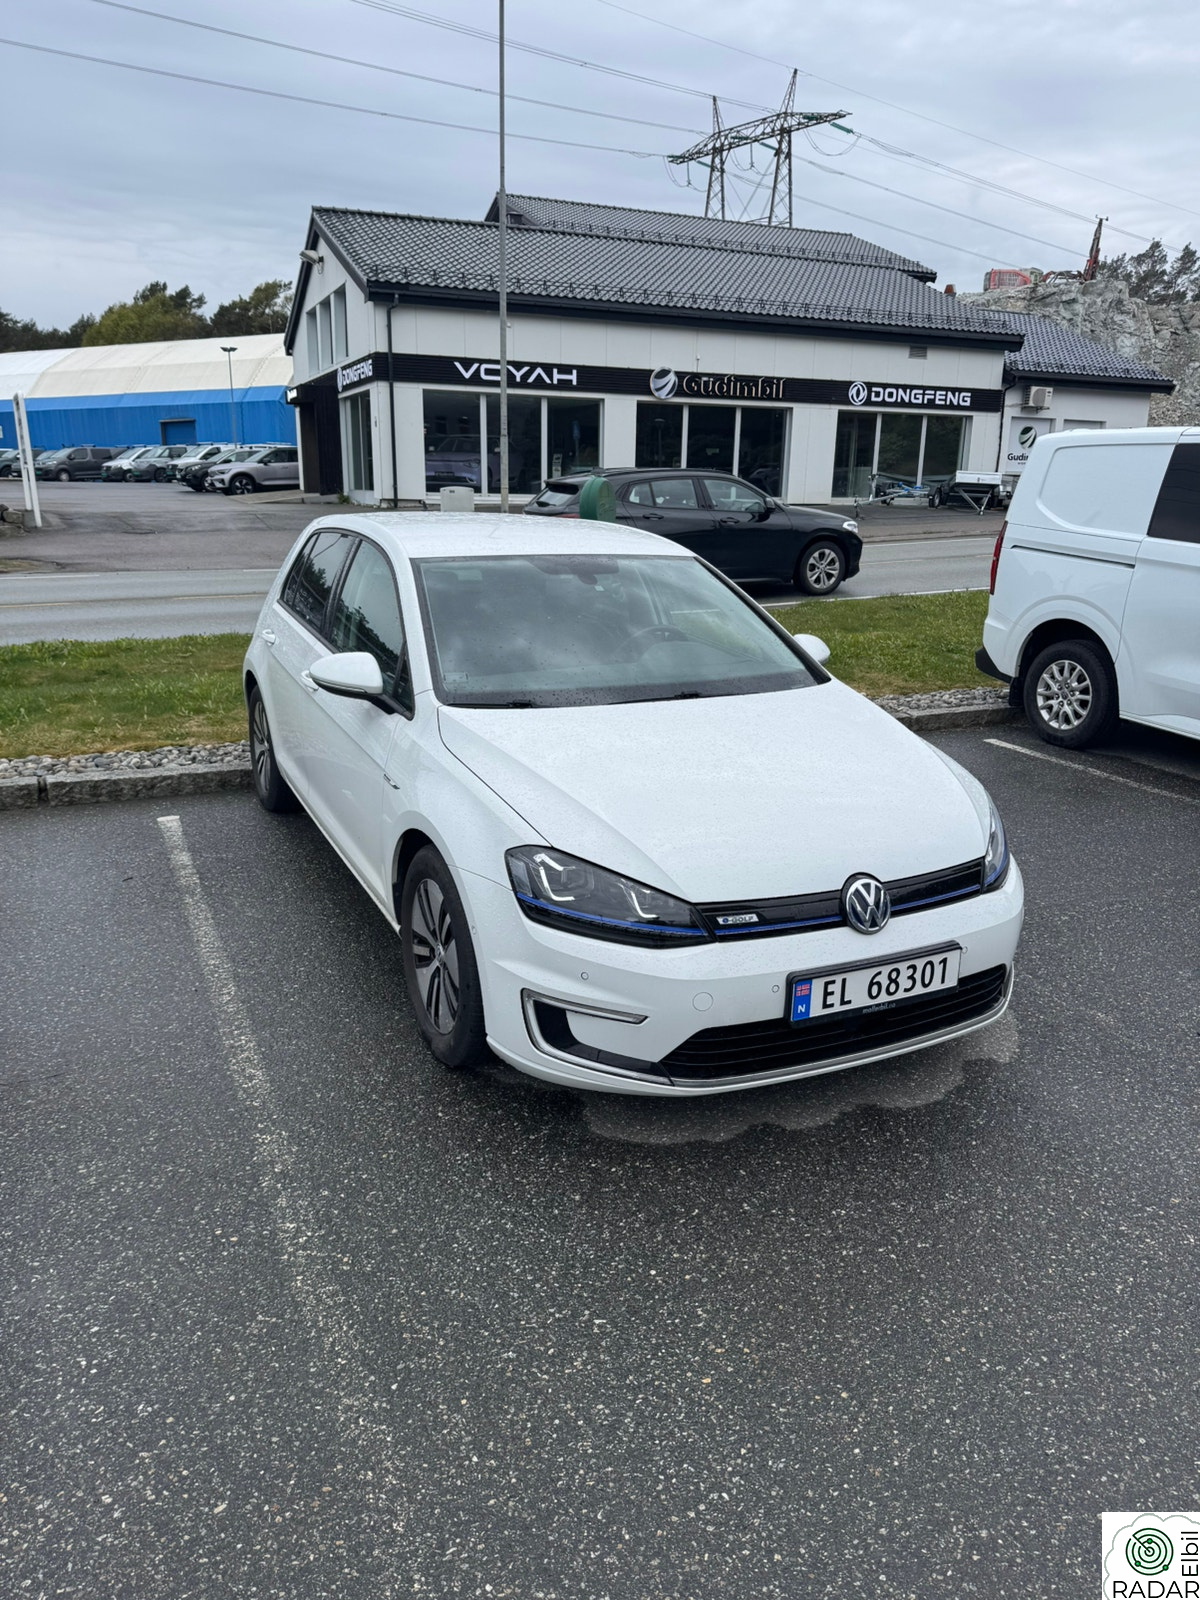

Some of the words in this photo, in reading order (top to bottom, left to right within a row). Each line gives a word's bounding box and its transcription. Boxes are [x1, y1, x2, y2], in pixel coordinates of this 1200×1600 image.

[342, 359, 373, 386] DONGFENG
[453, 361, 578, 386] VOYAH
[683, 374, 786, 399] Gudimbil
[871, 386, 972, 406] DONGFENG
[821, 977, 852, 1010] EL
[867, 956, 948, 1000] 68301
[797, 1003, 806, 1014] N
